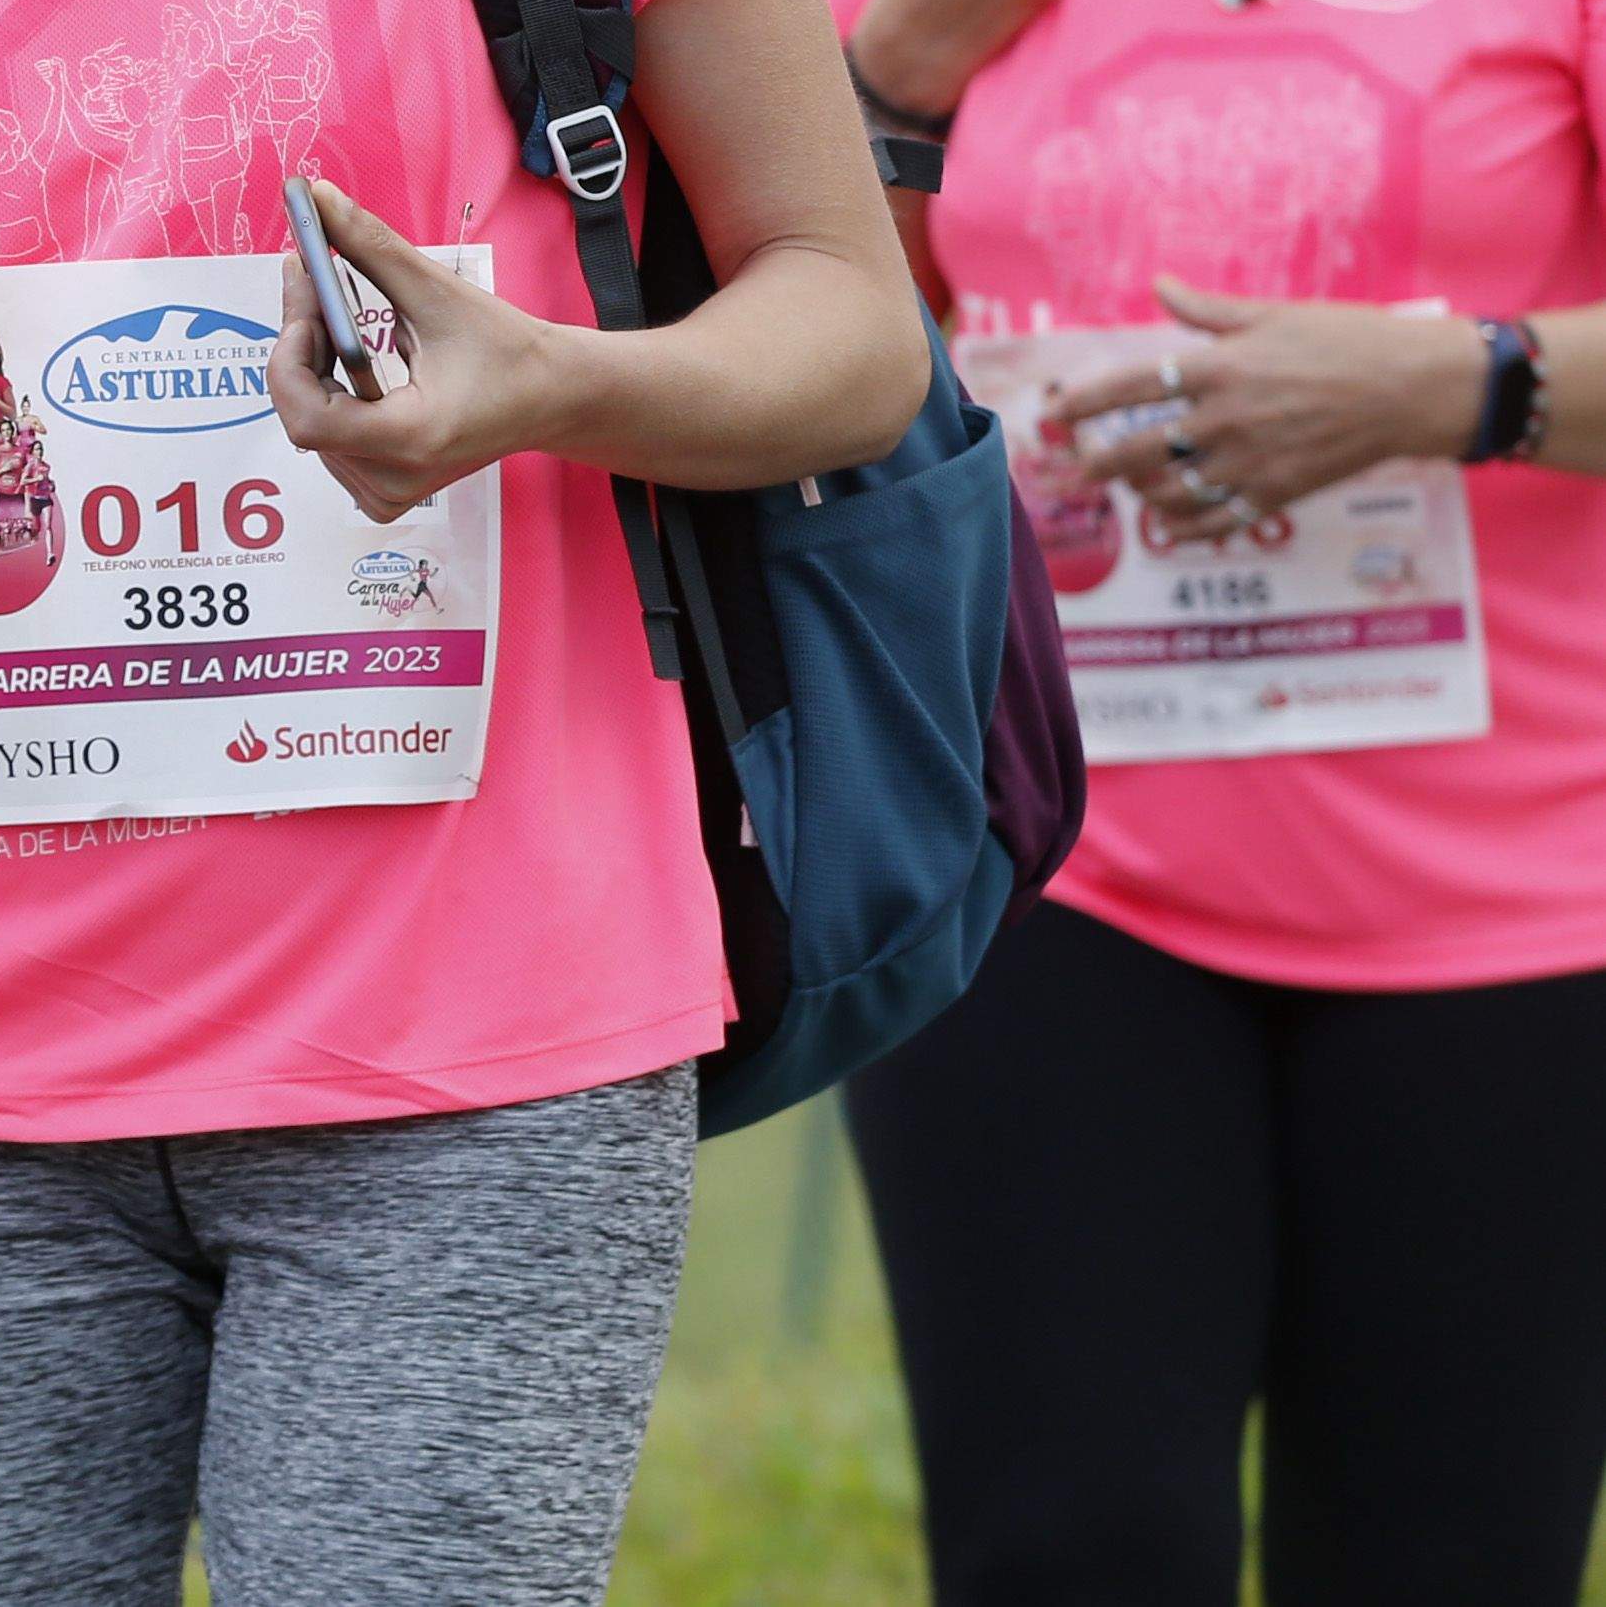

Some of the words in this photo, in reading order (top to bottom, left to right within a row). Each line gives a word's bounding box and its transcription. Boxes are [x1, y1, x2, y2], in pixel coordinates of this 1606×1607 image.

[100, 349, 187, 364] CENTRAL
[195, 346, 271, 360] LECHER
[61, 356, 272, 404] ASTURIAN
[80, 477, 285, 557] 016
[83, 557, 147, 572] TELÉFONO
[149, 556, 214, 570] VIOLENCIA
[216, 555, 233, 567] DE
[234, 550, 285, 566] GÉNERO
[347, 579, 400, 595] Carrera
[378, 594, 415, 617] Mujer
[123, 582, 251, 631] 3838
[123, 658, 173, 688] DE
[180, 655, 226, 685] LA
[233, 649, 349, 682] MUJER
[363, 645, 442, 674] 2023
[274, 721, 454, 761] Santander
[18, 828, 56, 858] DE
[62, 821, 99, 852] LA
